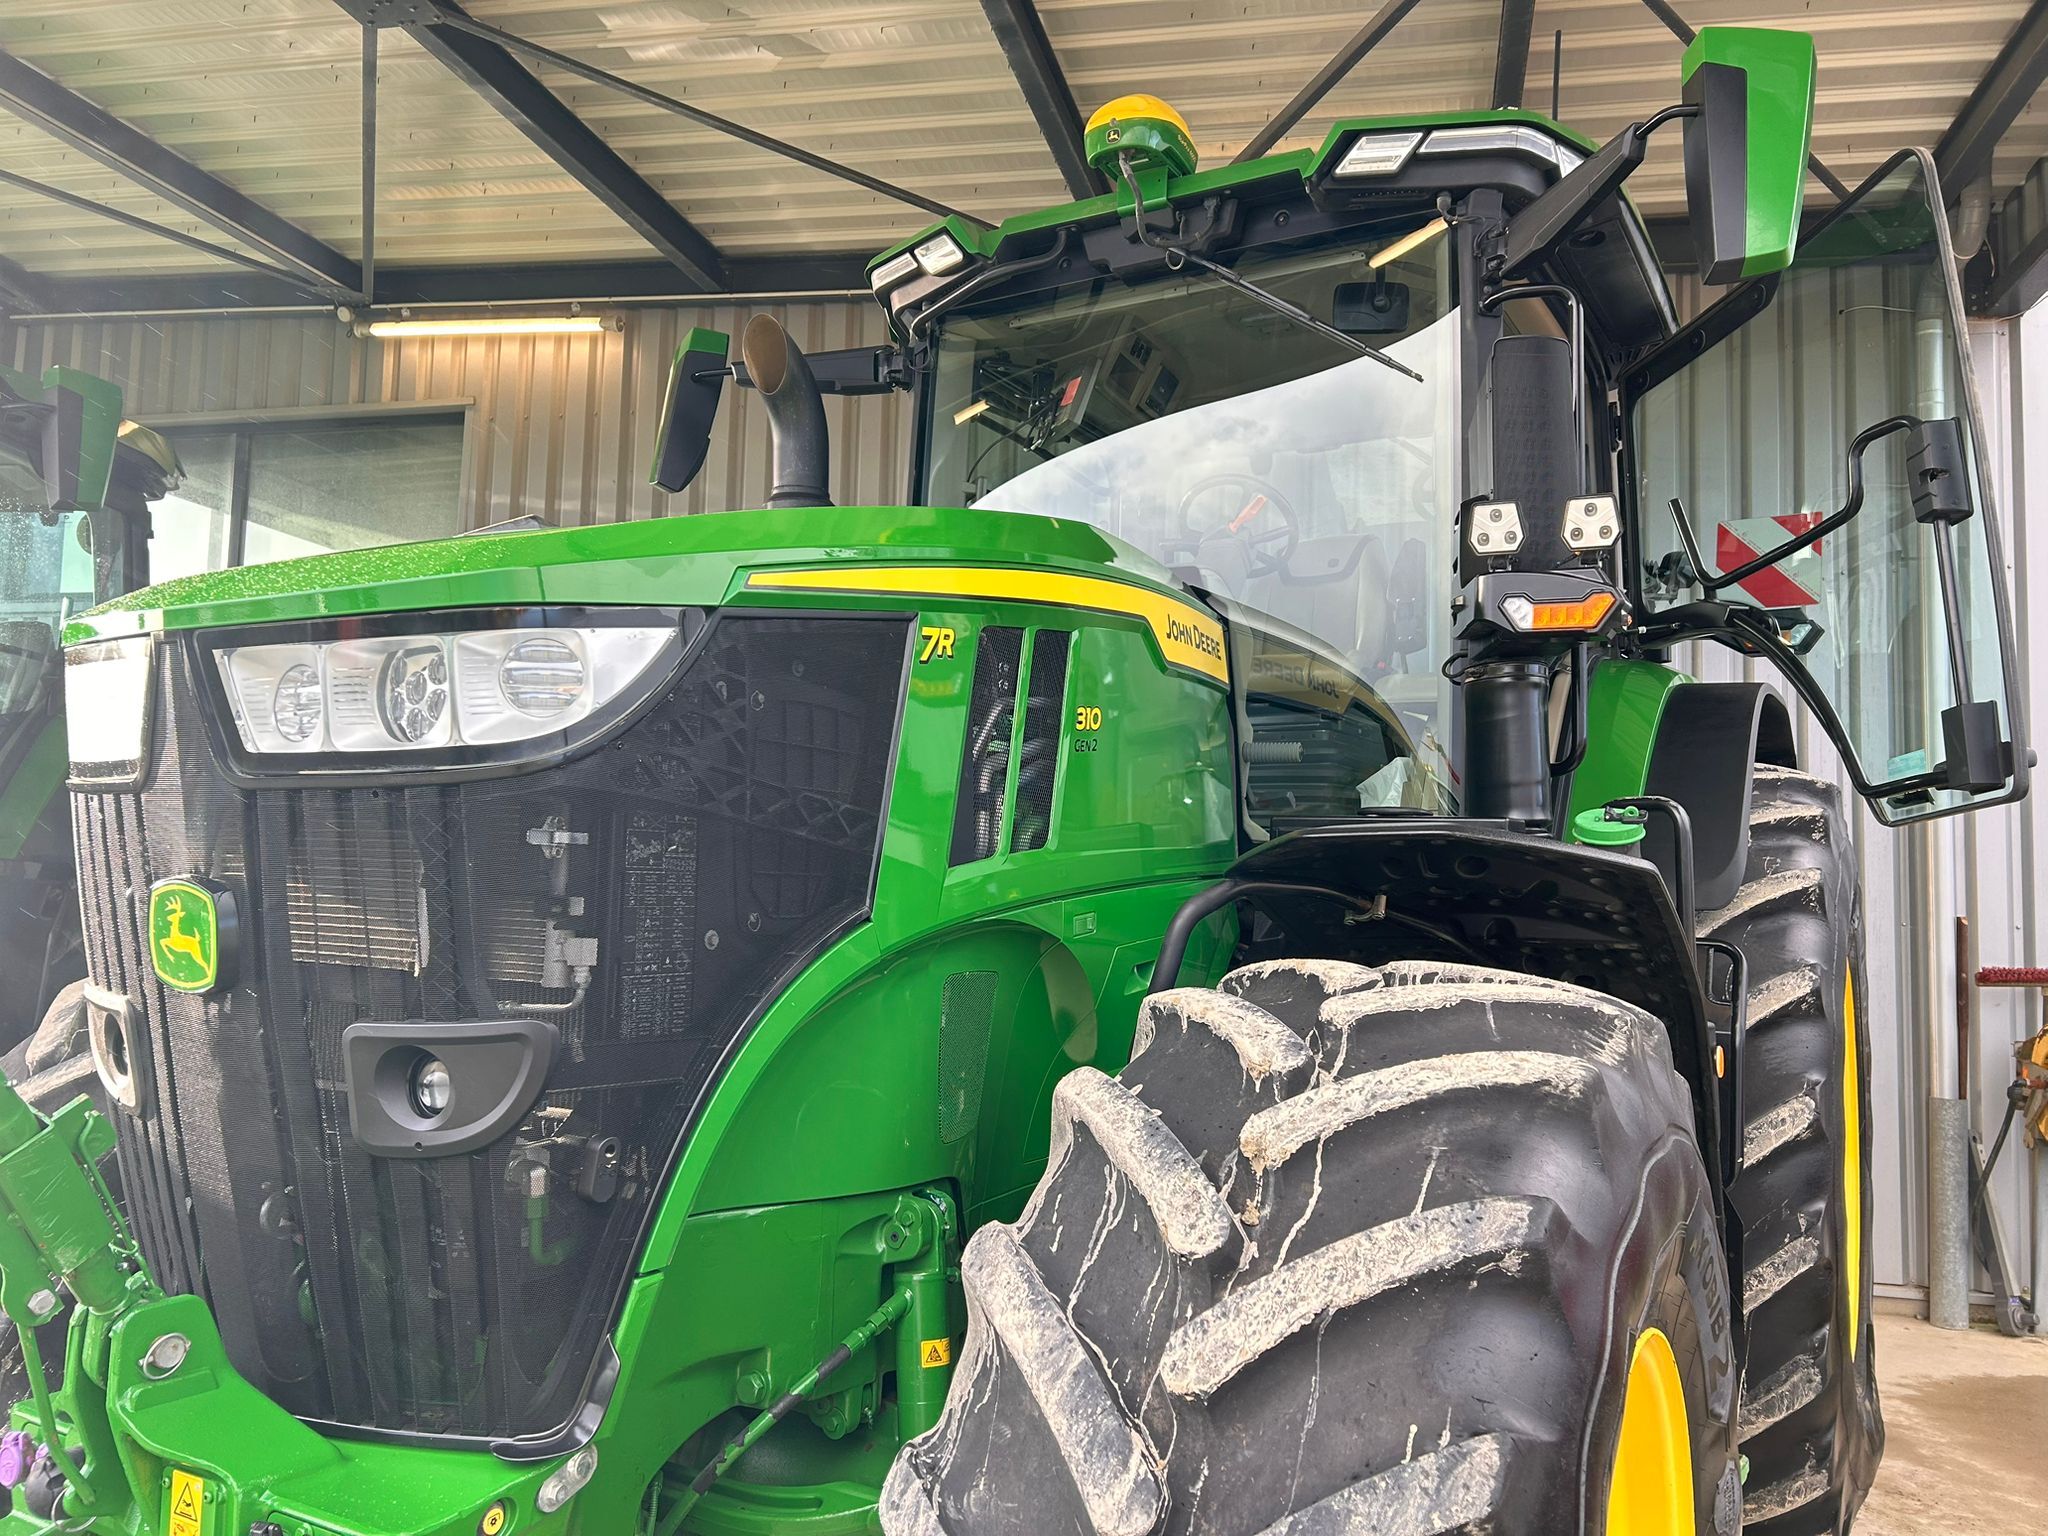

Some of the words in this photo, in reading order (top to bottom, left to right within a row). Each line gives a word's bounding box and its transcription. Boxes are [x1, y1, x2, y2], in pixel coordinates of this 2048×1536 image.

[918, 626, 956, 665] 7R
[1165, 613, 1193, 648] JOHN
[1193, 624, 1222, 661] DEERE
[1075, 705, 1103, 732] 310
